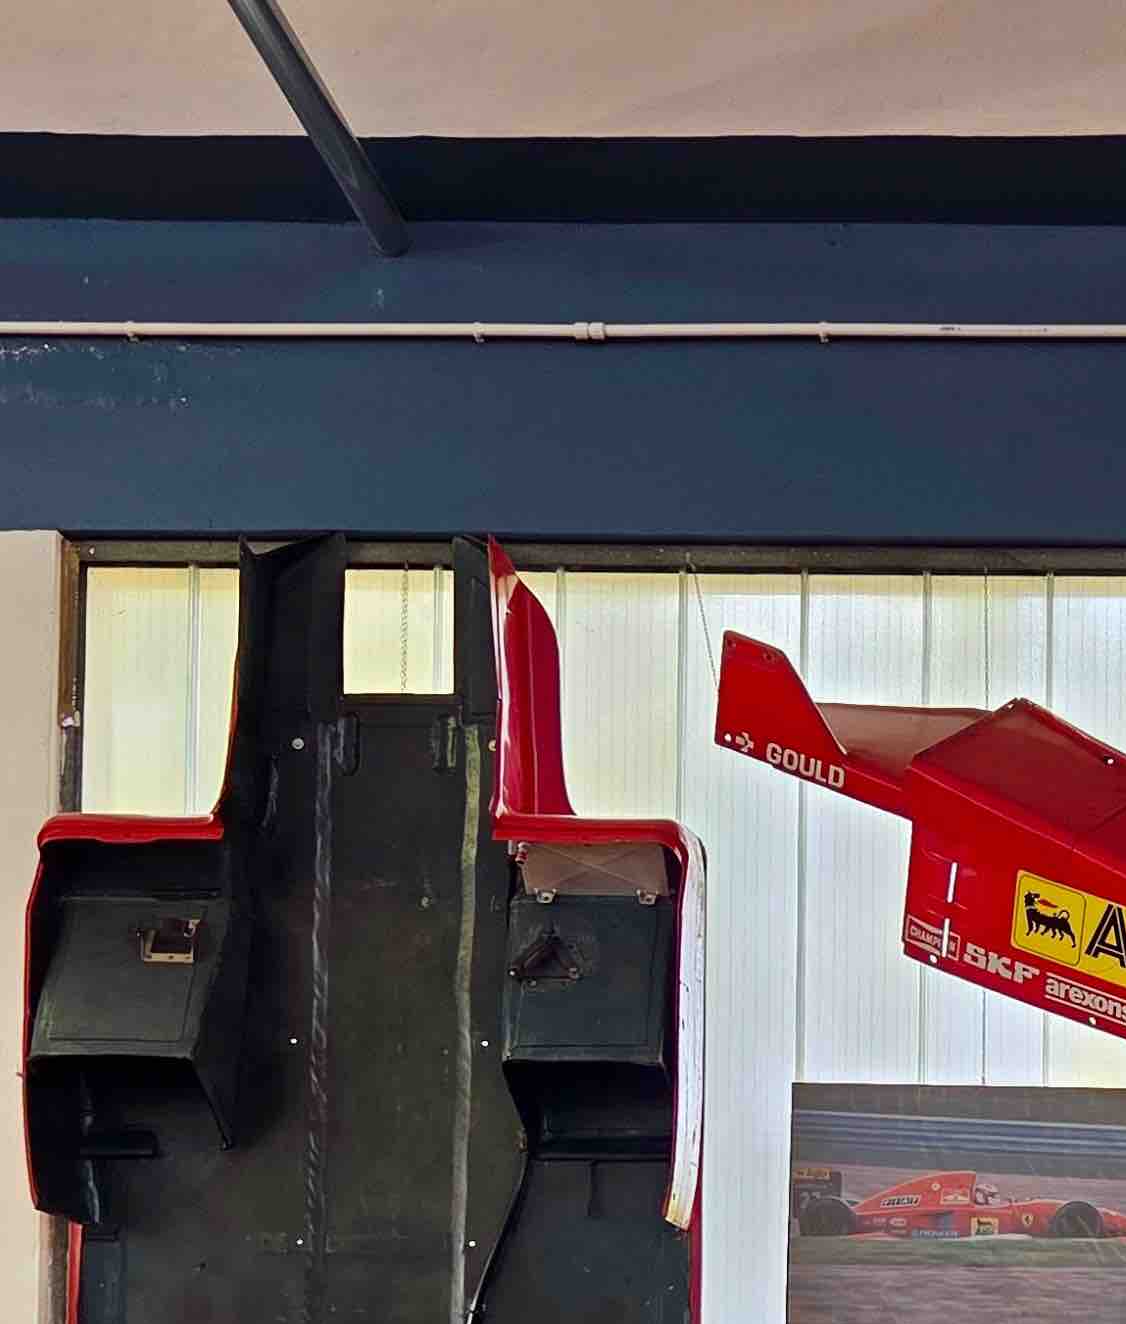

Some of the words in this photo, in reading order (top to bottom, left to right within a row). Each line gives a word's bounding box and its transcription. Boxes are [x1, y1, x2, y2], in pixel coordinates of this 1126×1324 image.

[765, 742, 846, 788] GOULD
[910, 926, 957, 953] CHAMPN
[962, 942, 1041, 985] SKF
